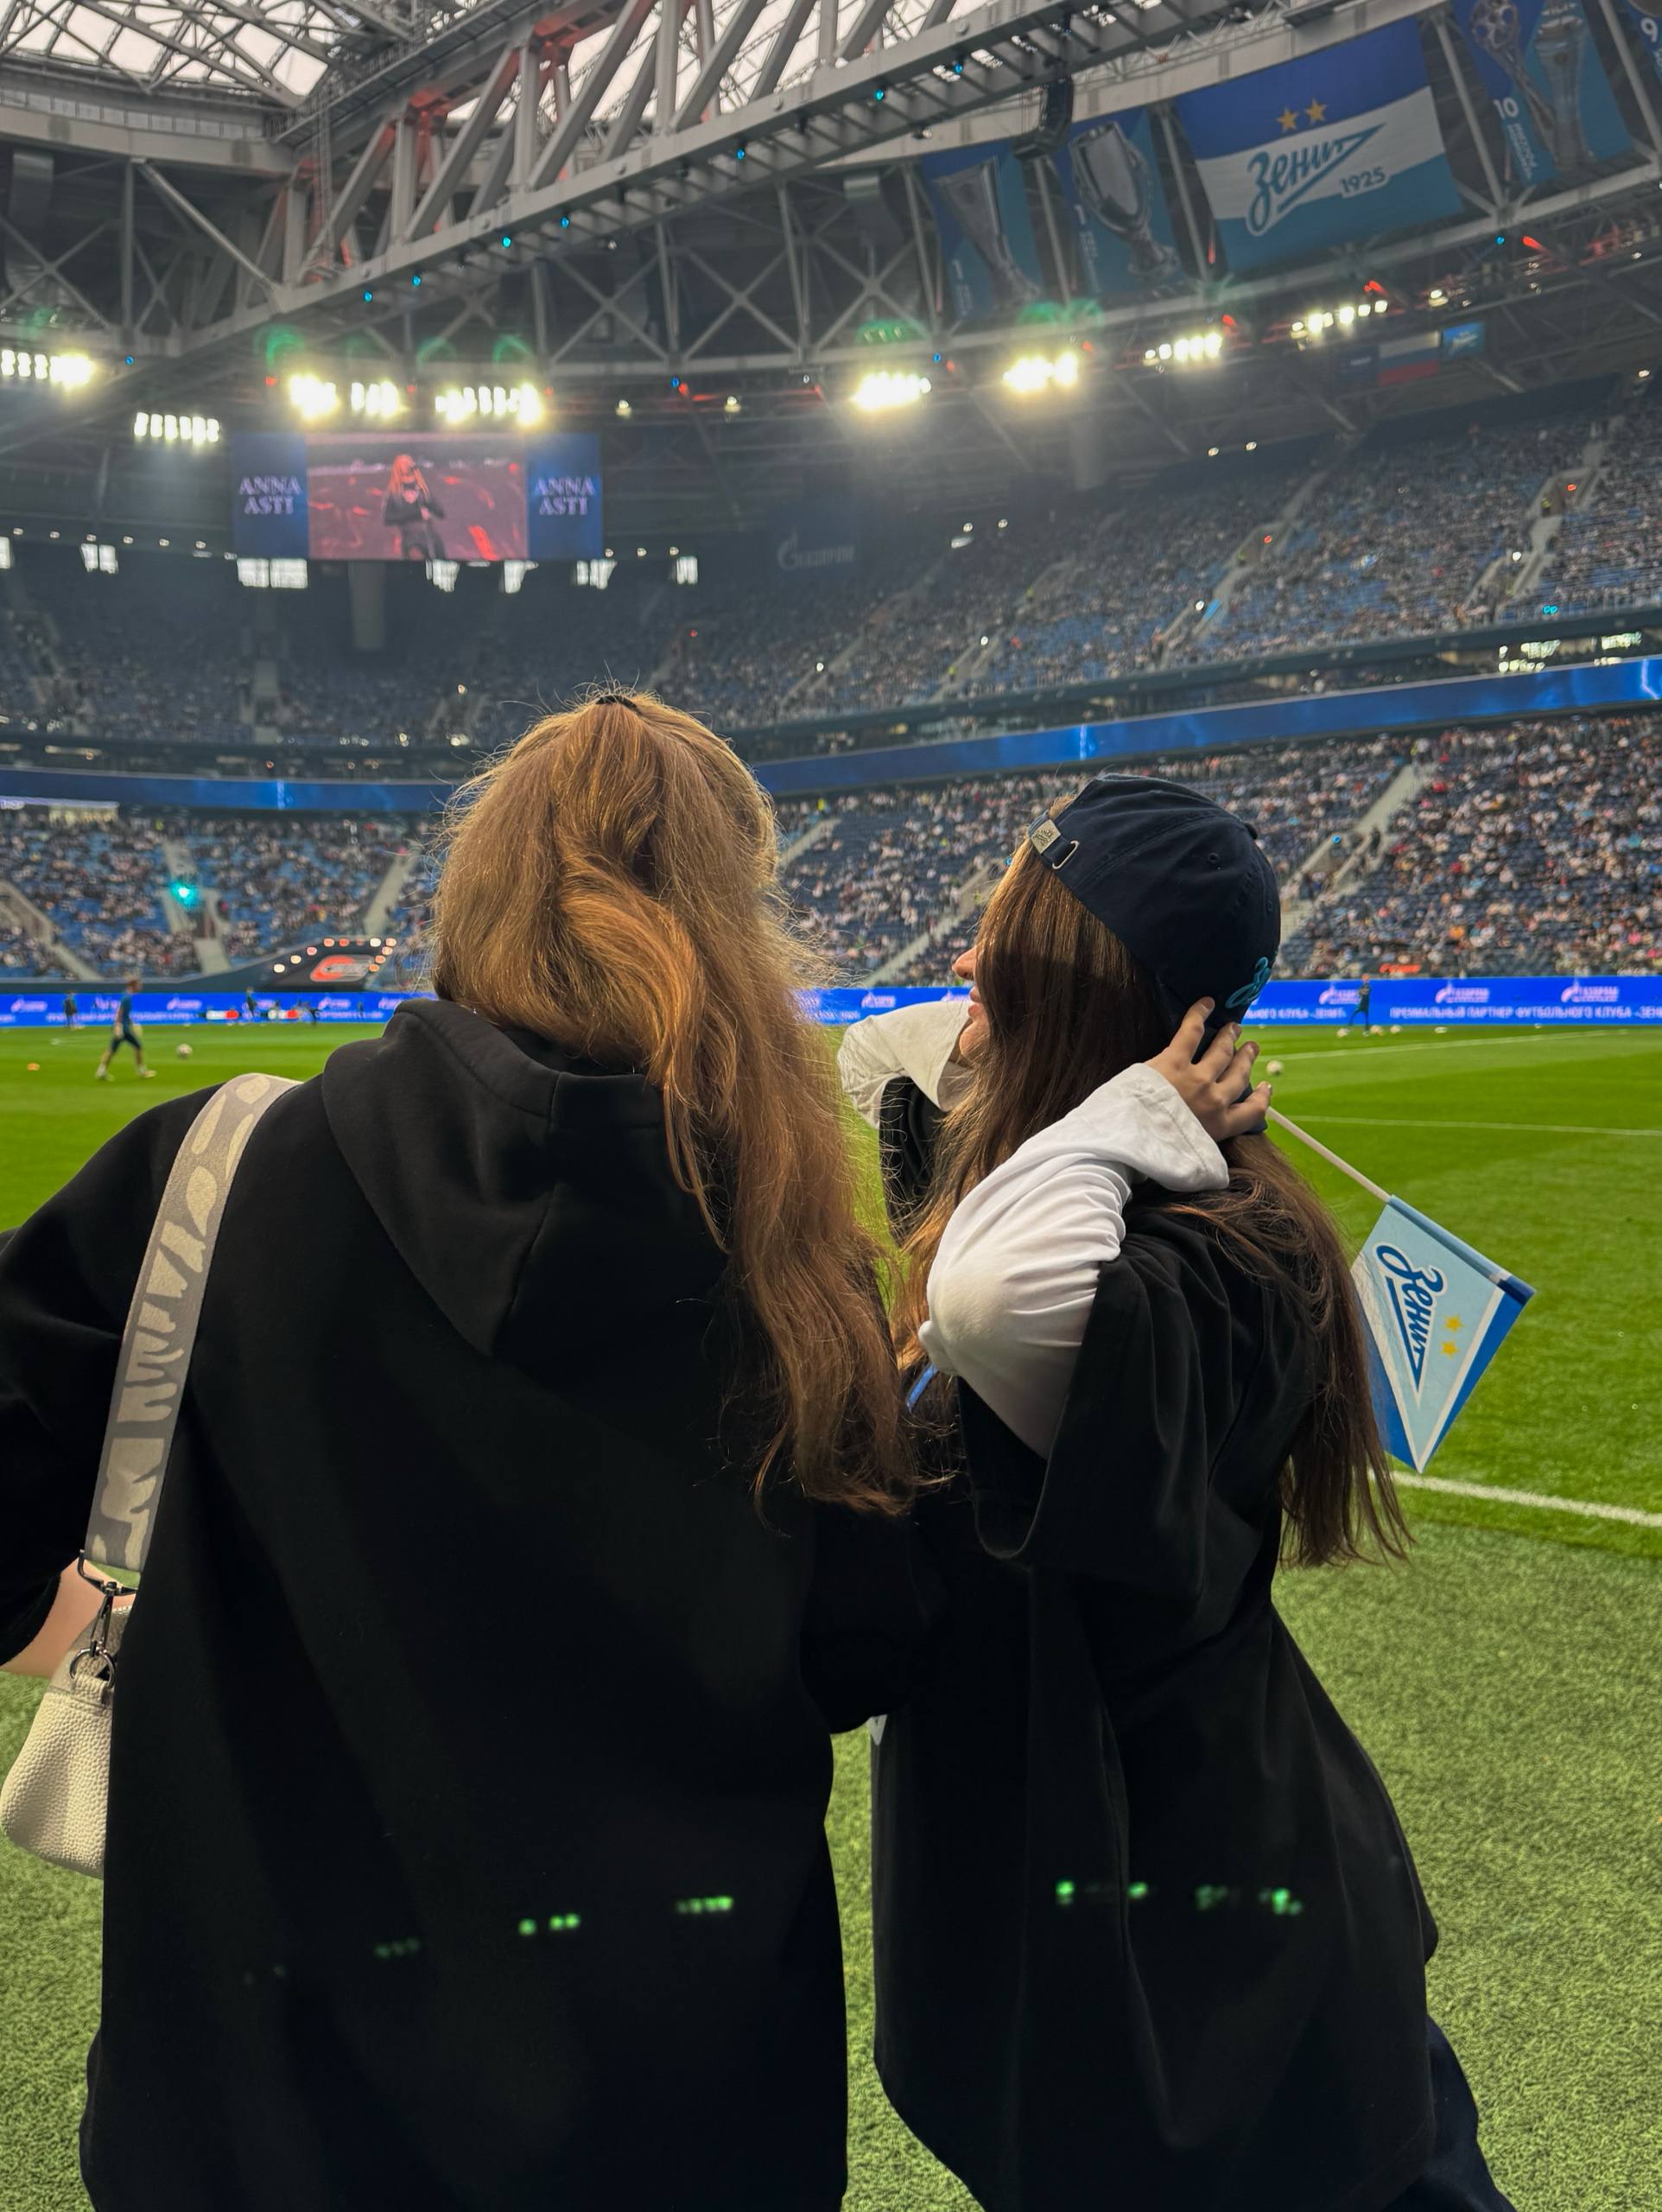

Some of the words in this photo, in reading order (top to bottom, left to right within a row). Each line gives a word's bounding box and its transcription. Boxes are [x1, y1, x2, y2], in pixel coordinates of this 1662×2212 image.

[1640, 17, 1659, 42] 9
[1493, 96, 1519, 120] 10
[1341, 168, 1385, 194] 1925
[238, 476, 302, 495] ANNA
[534, 476, 597, 496] ANNA
[244, 496, 295, 515] ASTI
[539, 496, 589, 515] ASTI
[1376, 1244, 1444, 1394] Зенит
